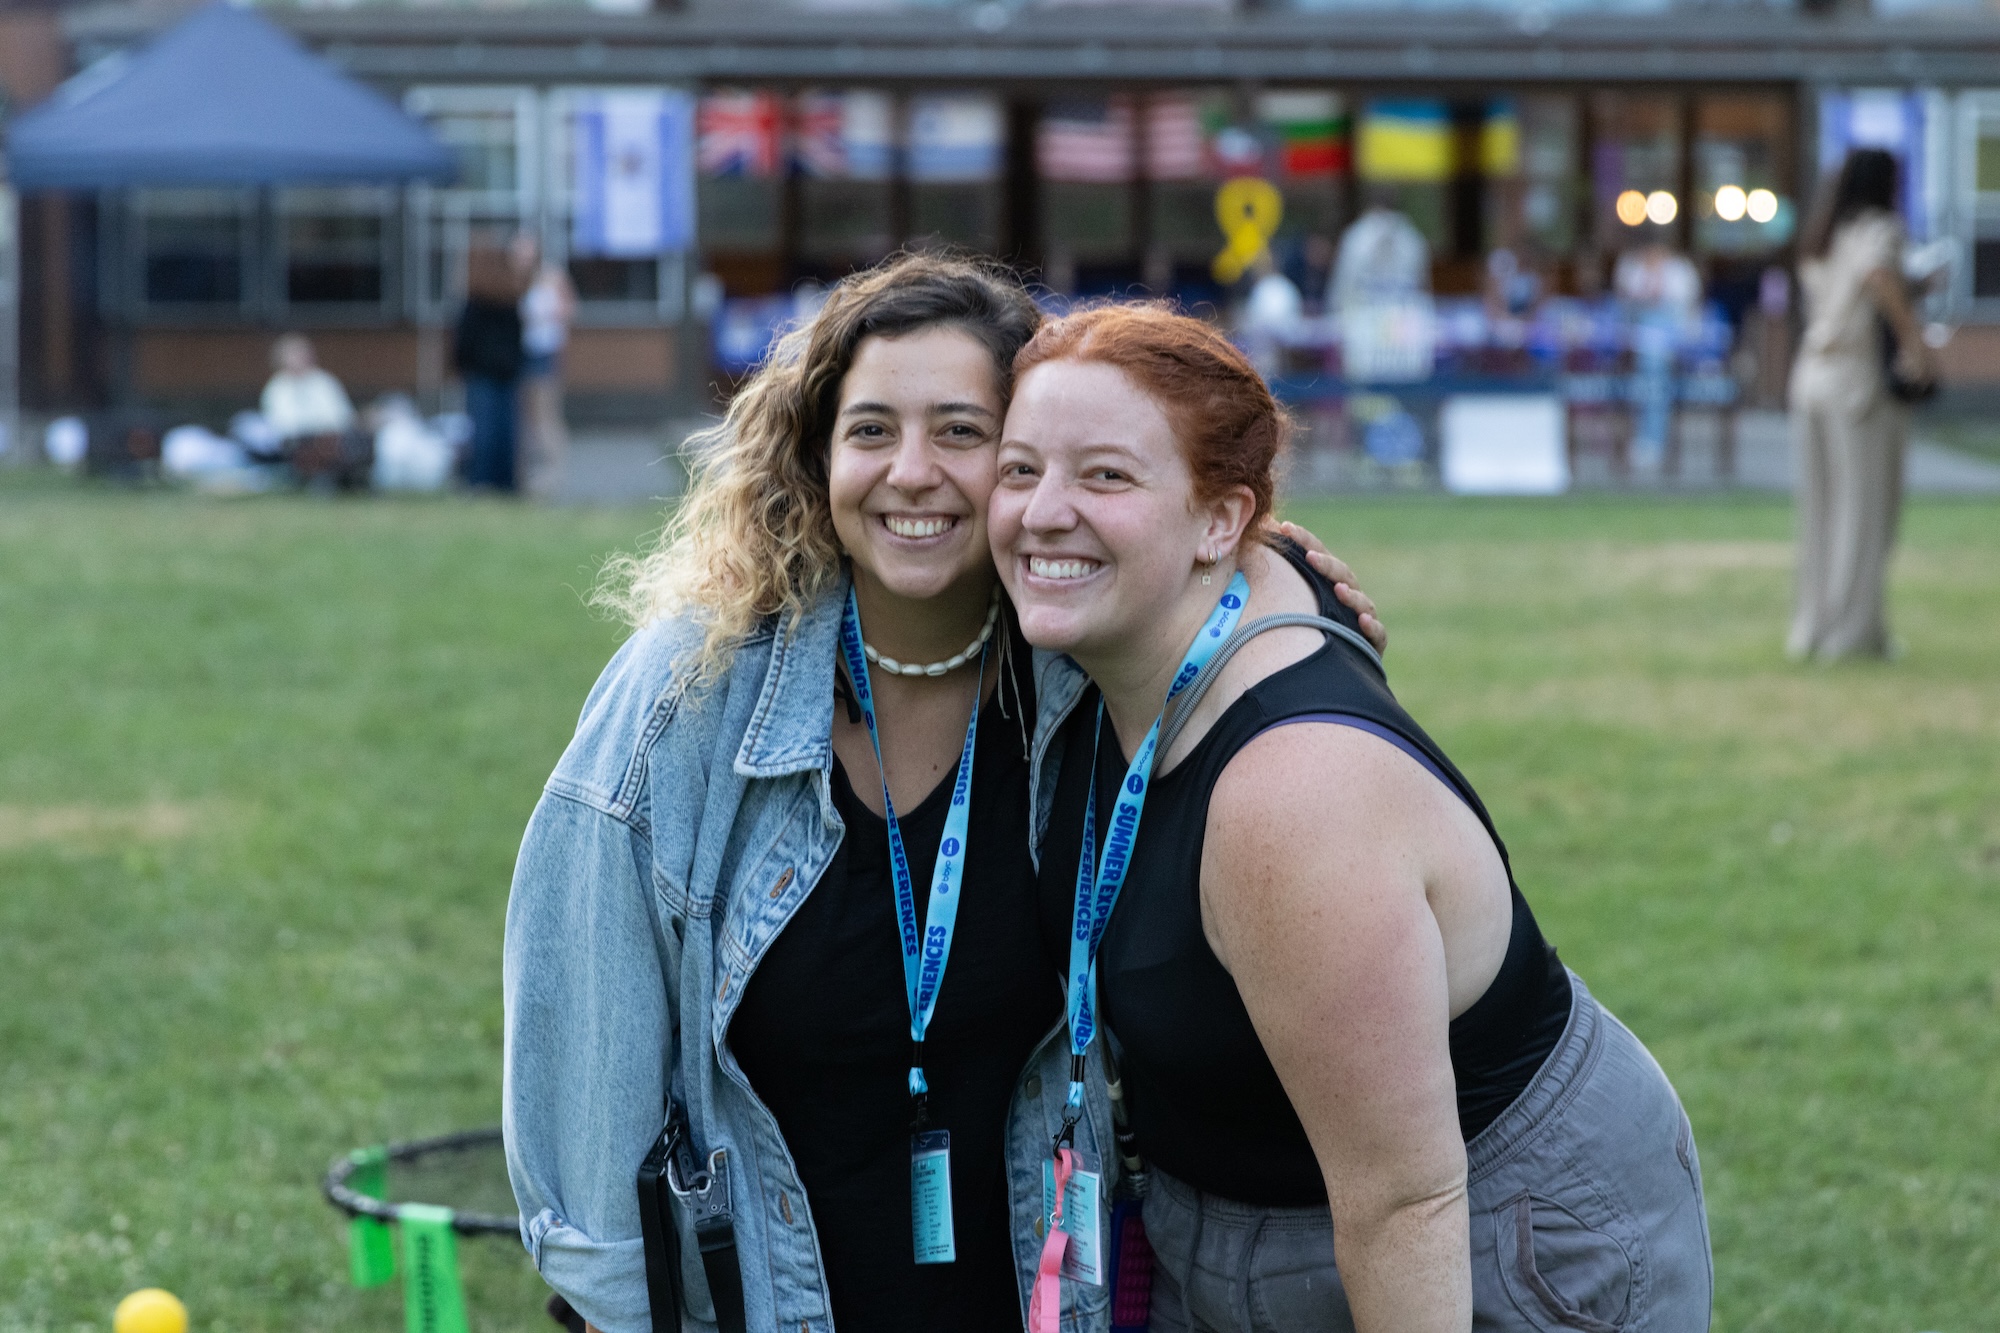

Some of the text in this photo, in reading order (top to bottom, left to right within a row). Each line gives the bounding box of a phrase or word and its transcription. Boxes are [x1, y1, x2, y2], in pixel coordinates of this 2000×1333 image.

[841, 618, 869, 700] SUMMER
[952, 727, 974, 807] SUMMER
[1076, 816, 1095, 942] EXPERIENCES
[1102, 802, 1138, 881] SUMMER
[891, 833, 917, 957] EXPERIENCES
